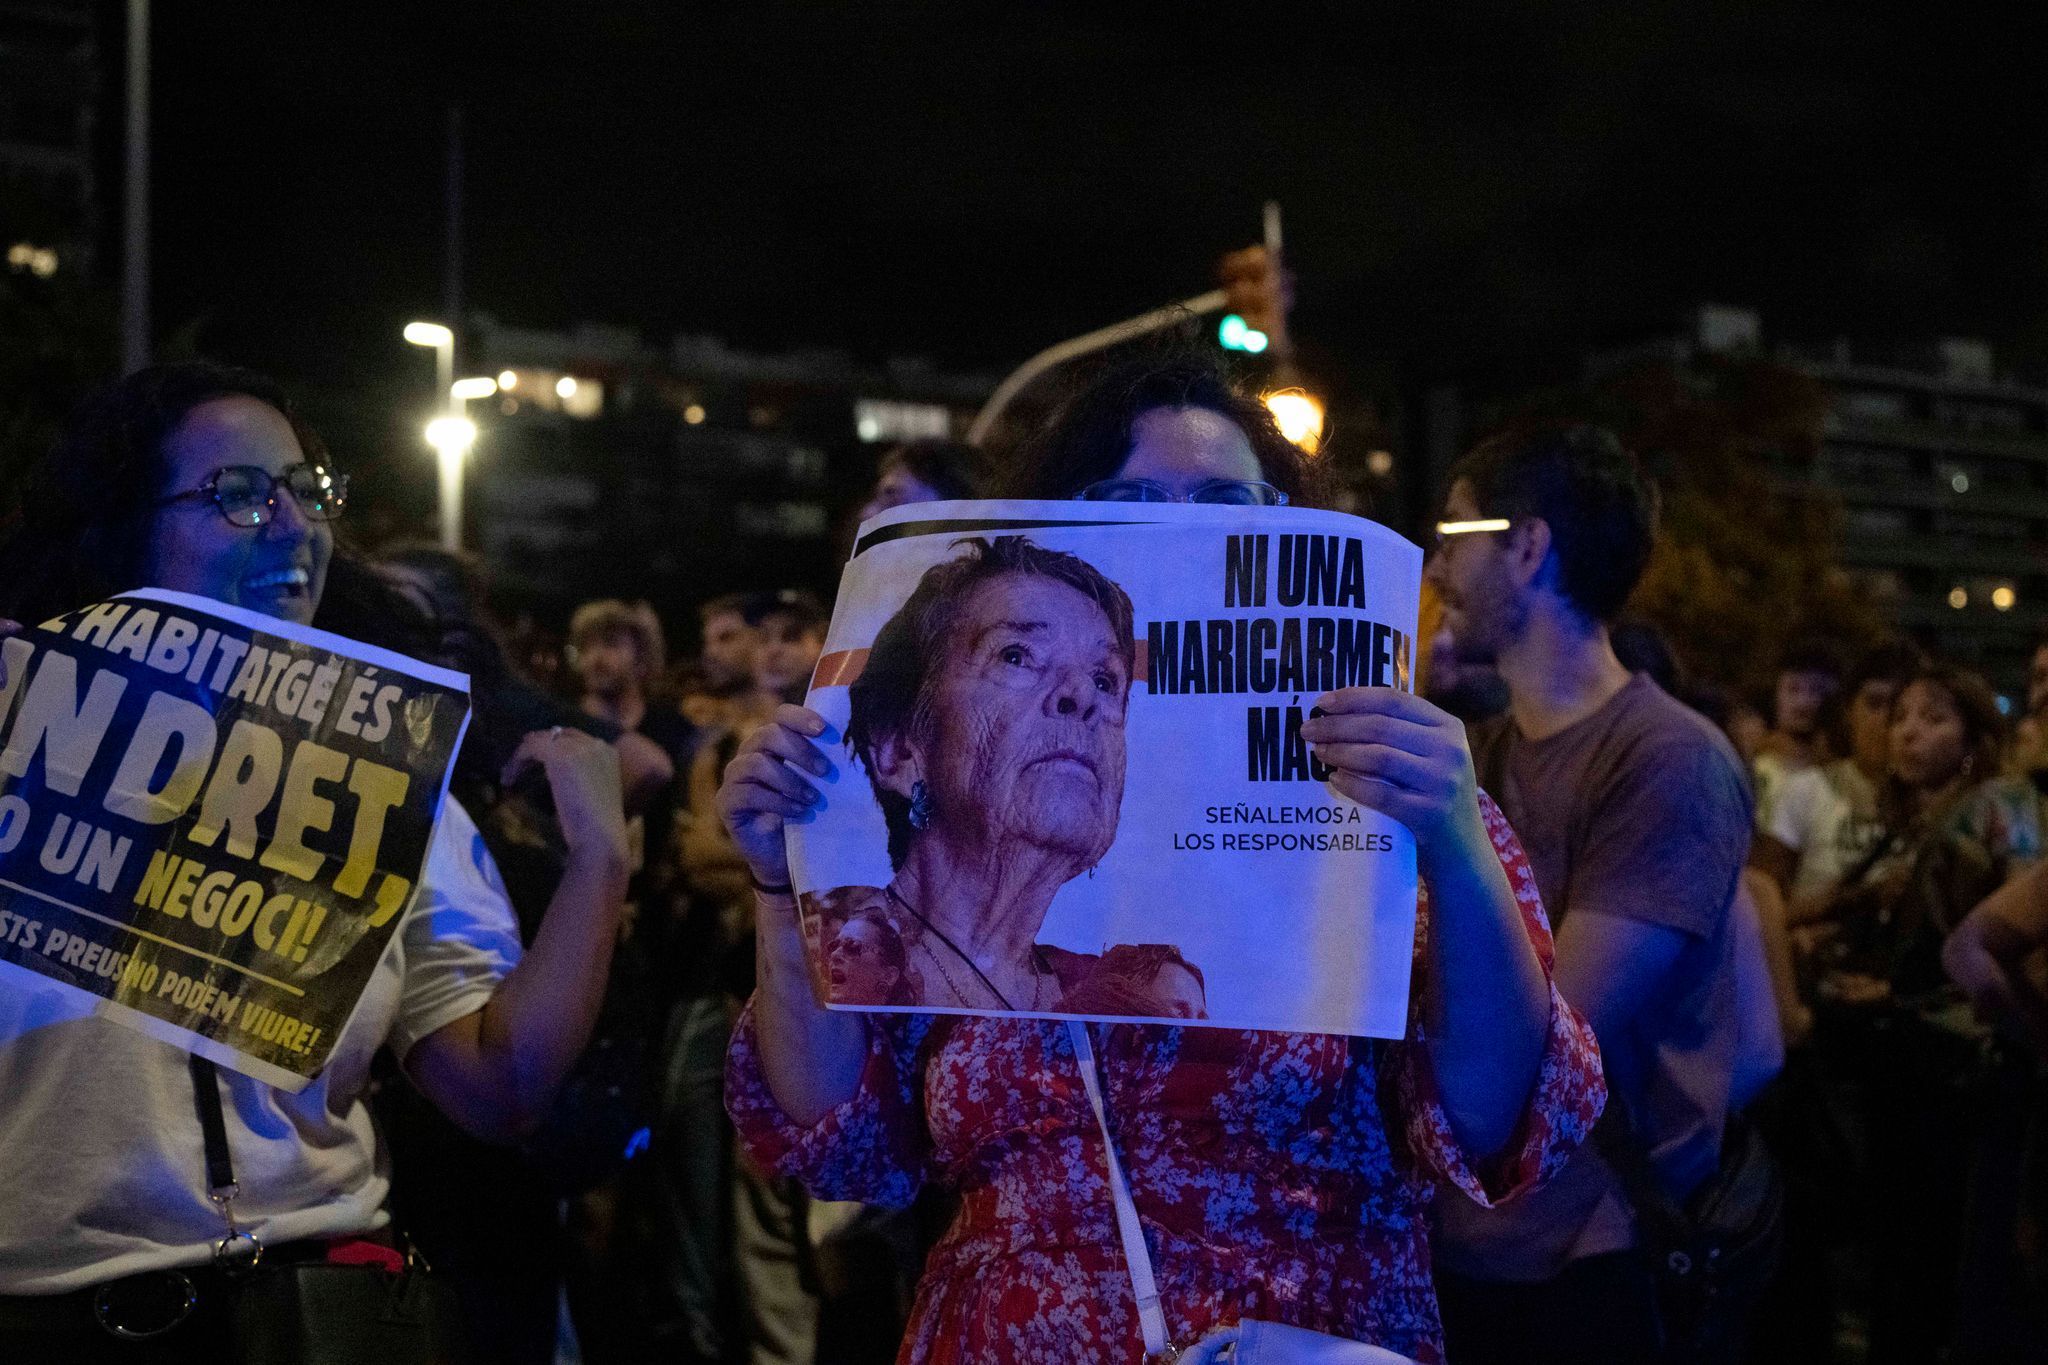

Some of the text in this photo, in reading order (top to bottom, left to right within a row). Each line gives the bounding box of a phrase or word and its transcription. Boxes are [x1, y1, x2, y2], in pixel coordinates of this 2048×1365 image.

[1224, 534, 1366, 610] NI UNA
[1147, 617, 1411, 695] MARICARMEN
[335, 667, 403, 743] ÉS
[102, 690, 411, 928] DRET,
[1173, 832, 1393, 852] LOS RESPONSABLES
[1205, 802, 1361, 824] SEÑALEMOS A
[39, 812, 134, 895] UN
[133, 848, 327, 964] NEGOCI!
[42, 928, 131, 982] PREUS
[126, 956, 160, 993] NO
[157, 969, 242, 1024] PODEM
[239, 1001, 321, 1056] VIURE!
